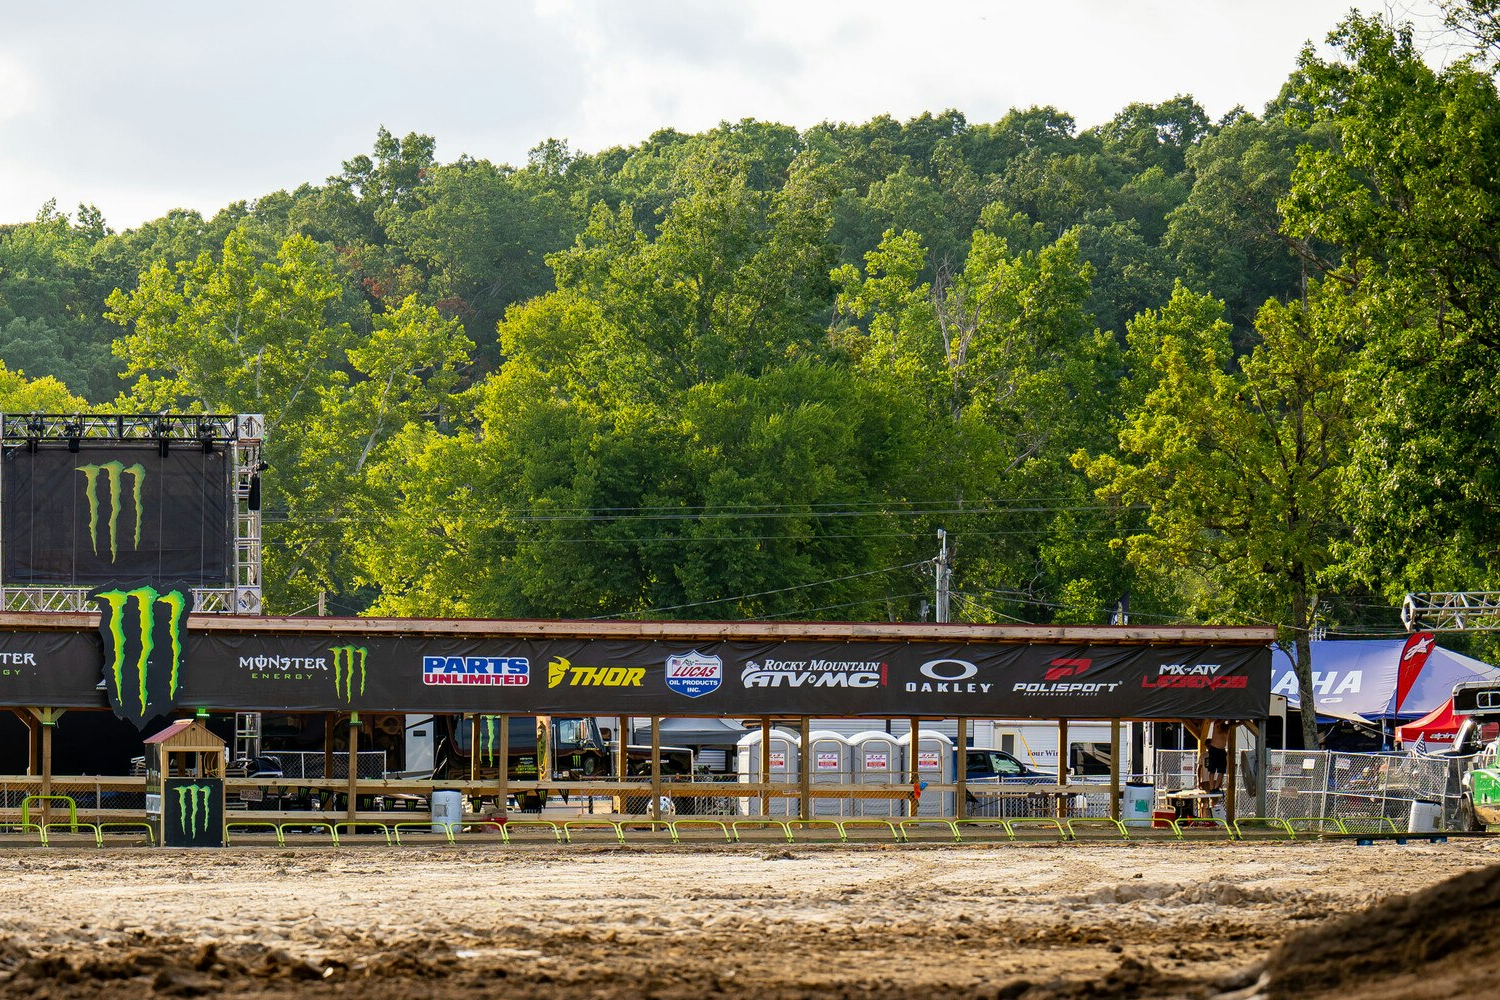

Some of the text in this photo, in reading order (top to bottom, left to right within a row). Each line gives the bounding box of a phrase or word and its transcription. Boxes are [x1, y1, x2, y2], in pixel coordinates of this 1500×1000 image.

[239, 655, 328, 671] MONSTER
[424, 657, 529, 674] PARTS
[763, 660, 880, 672] ROCKY MOUNTAIN
[672, 667, 718, 677] LUCAS
[1159, 664, 1186, 675] MX
[1189, 664, 1221, 675] ATV
[424, 674, 528, 685] UNLIMITED
[570, 667, 647, 687] THOR
[1141, 675, 1248, 691] LEGENDS
[1271, 671, 1362, 694] AHA
[905, 682, 991, 693] OAKLEY
[1012, 683, 1118, 692] POLISPORT
